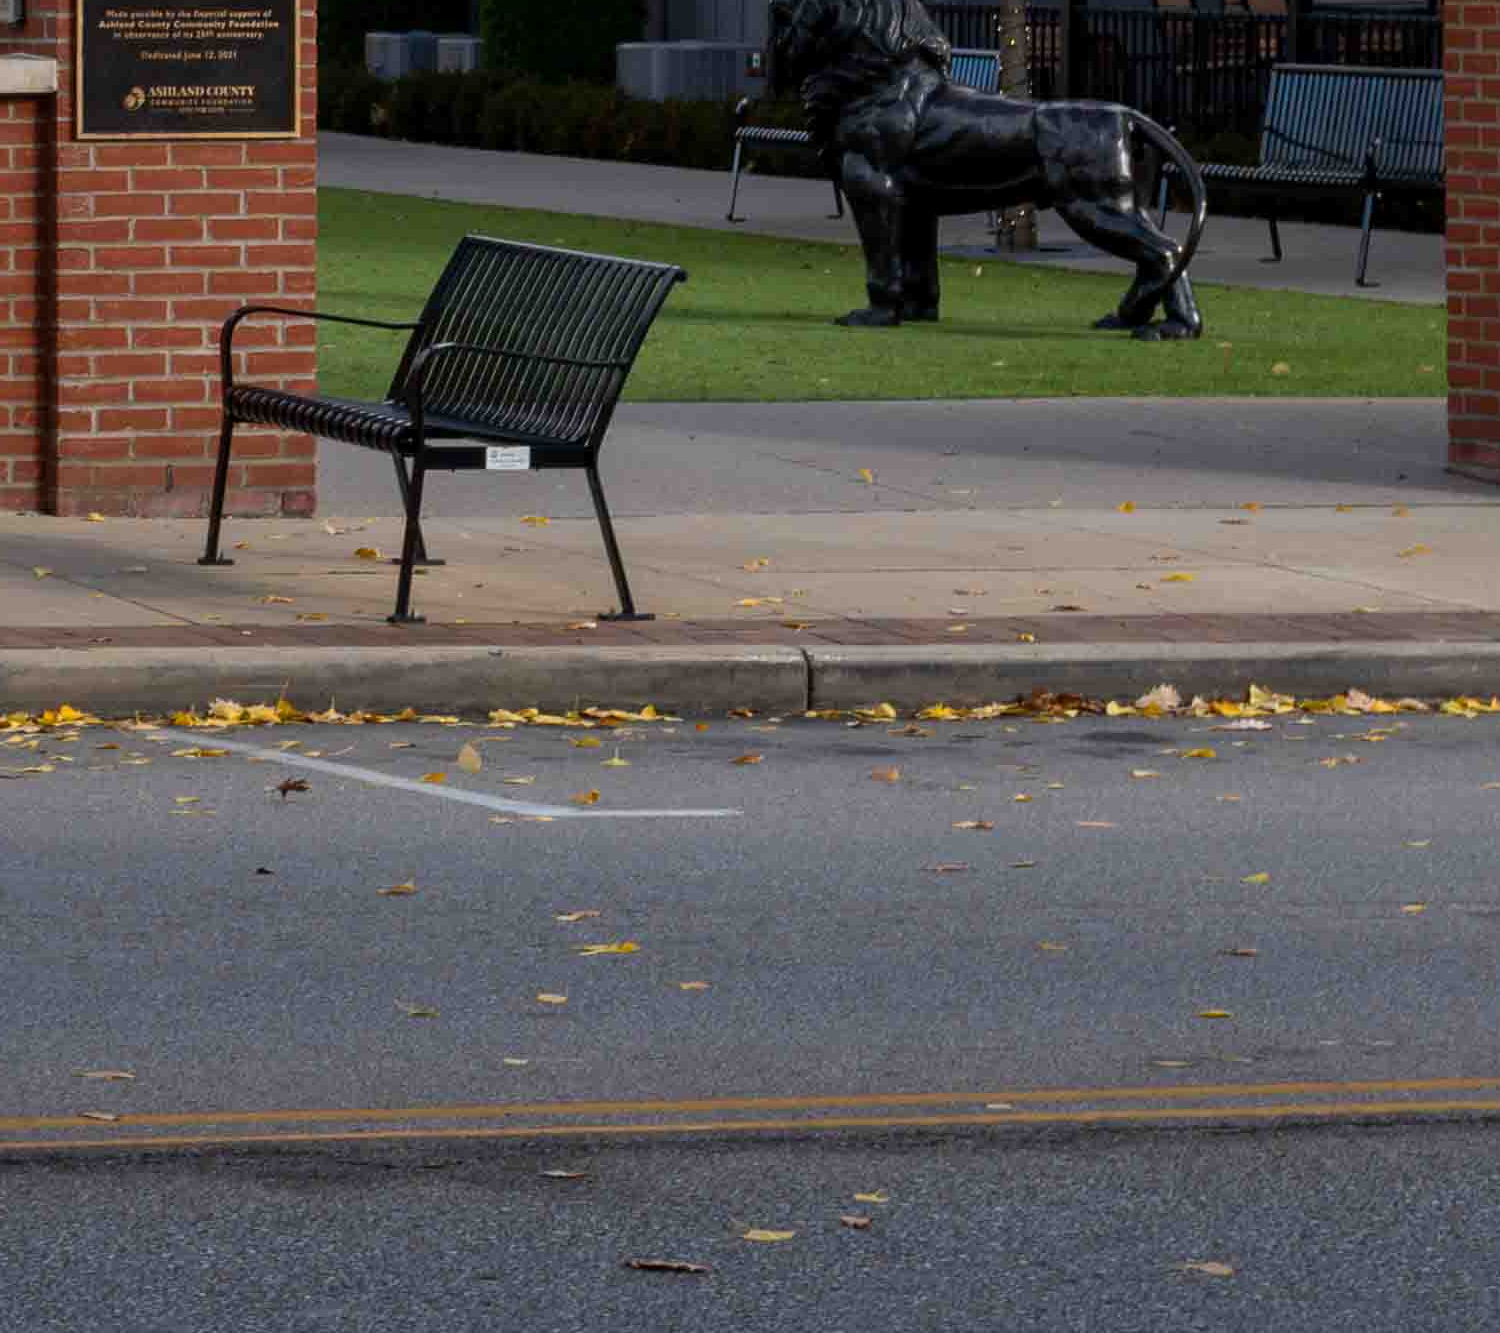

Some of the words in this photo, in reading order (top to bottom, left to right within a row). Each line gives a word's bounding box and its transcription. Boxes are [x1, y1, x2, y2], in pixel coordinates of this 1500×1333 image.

[98, 20, 136, 29] Ashland
[137, 20, 171, 30] County
[173, 20, 226, 30] Community
[228, 20, 280, 29] Foundation
[149, 85, 205, 98] ASHLAND
[206, 85, 256, 98] COUNTY
